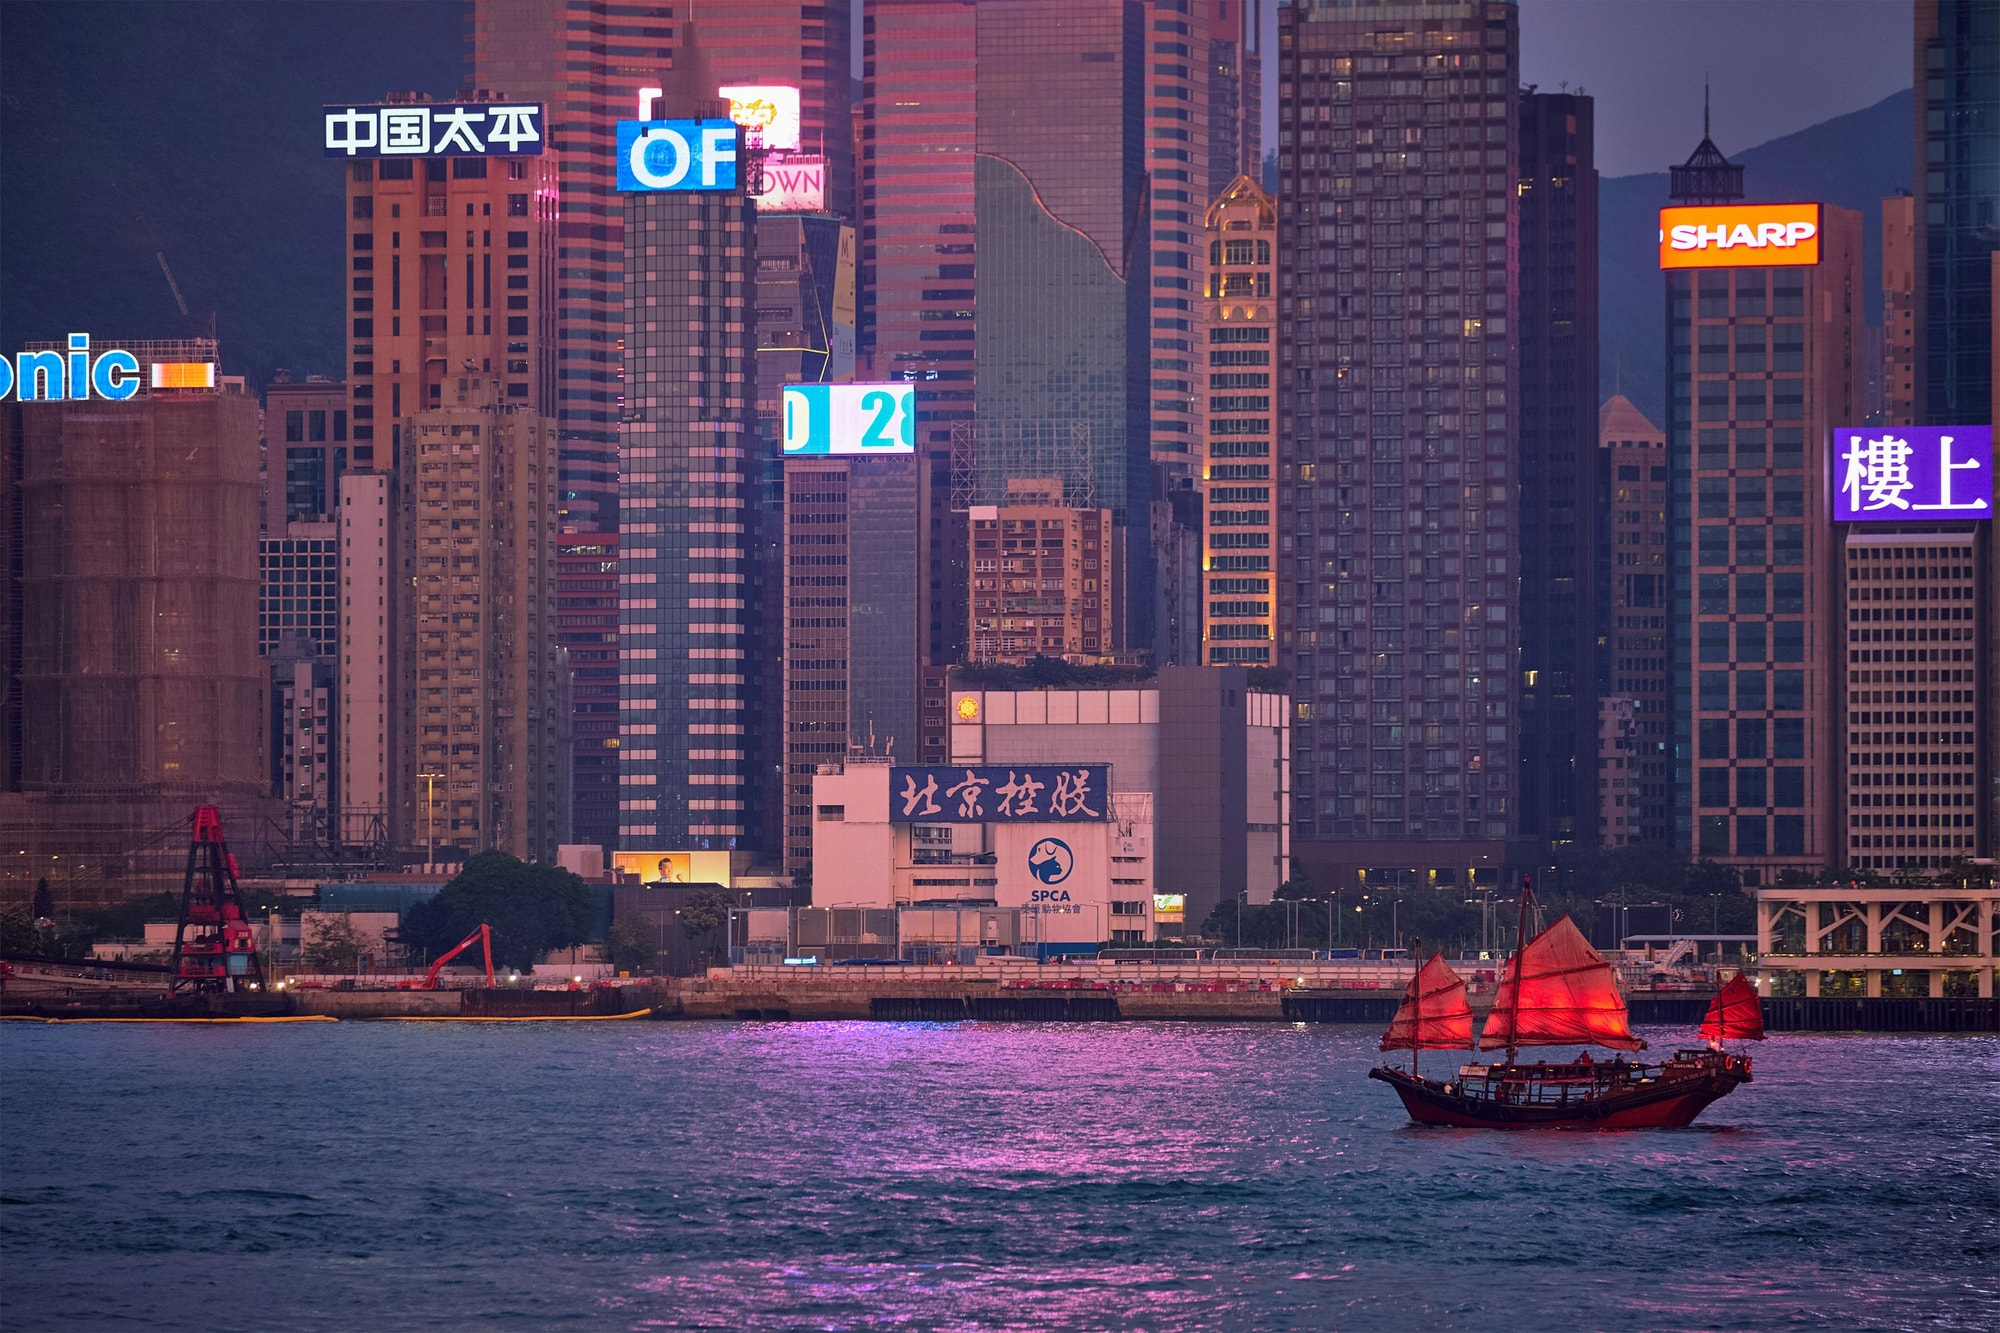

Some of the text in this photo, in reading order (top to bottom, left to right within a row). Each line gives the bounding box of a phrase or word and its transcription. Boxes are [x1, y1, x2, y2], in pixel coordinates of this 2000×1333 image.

[325, 106, 540, 155] 中国太平
[1670, 222, 1816, 250] SHARP
[0, 332, 141, 402] nic
[1841, 434, 1988, 512] 樓上
[900, 769, 1099, 819] 北京控股
[1031, 889, 1071, 902] SPCA
